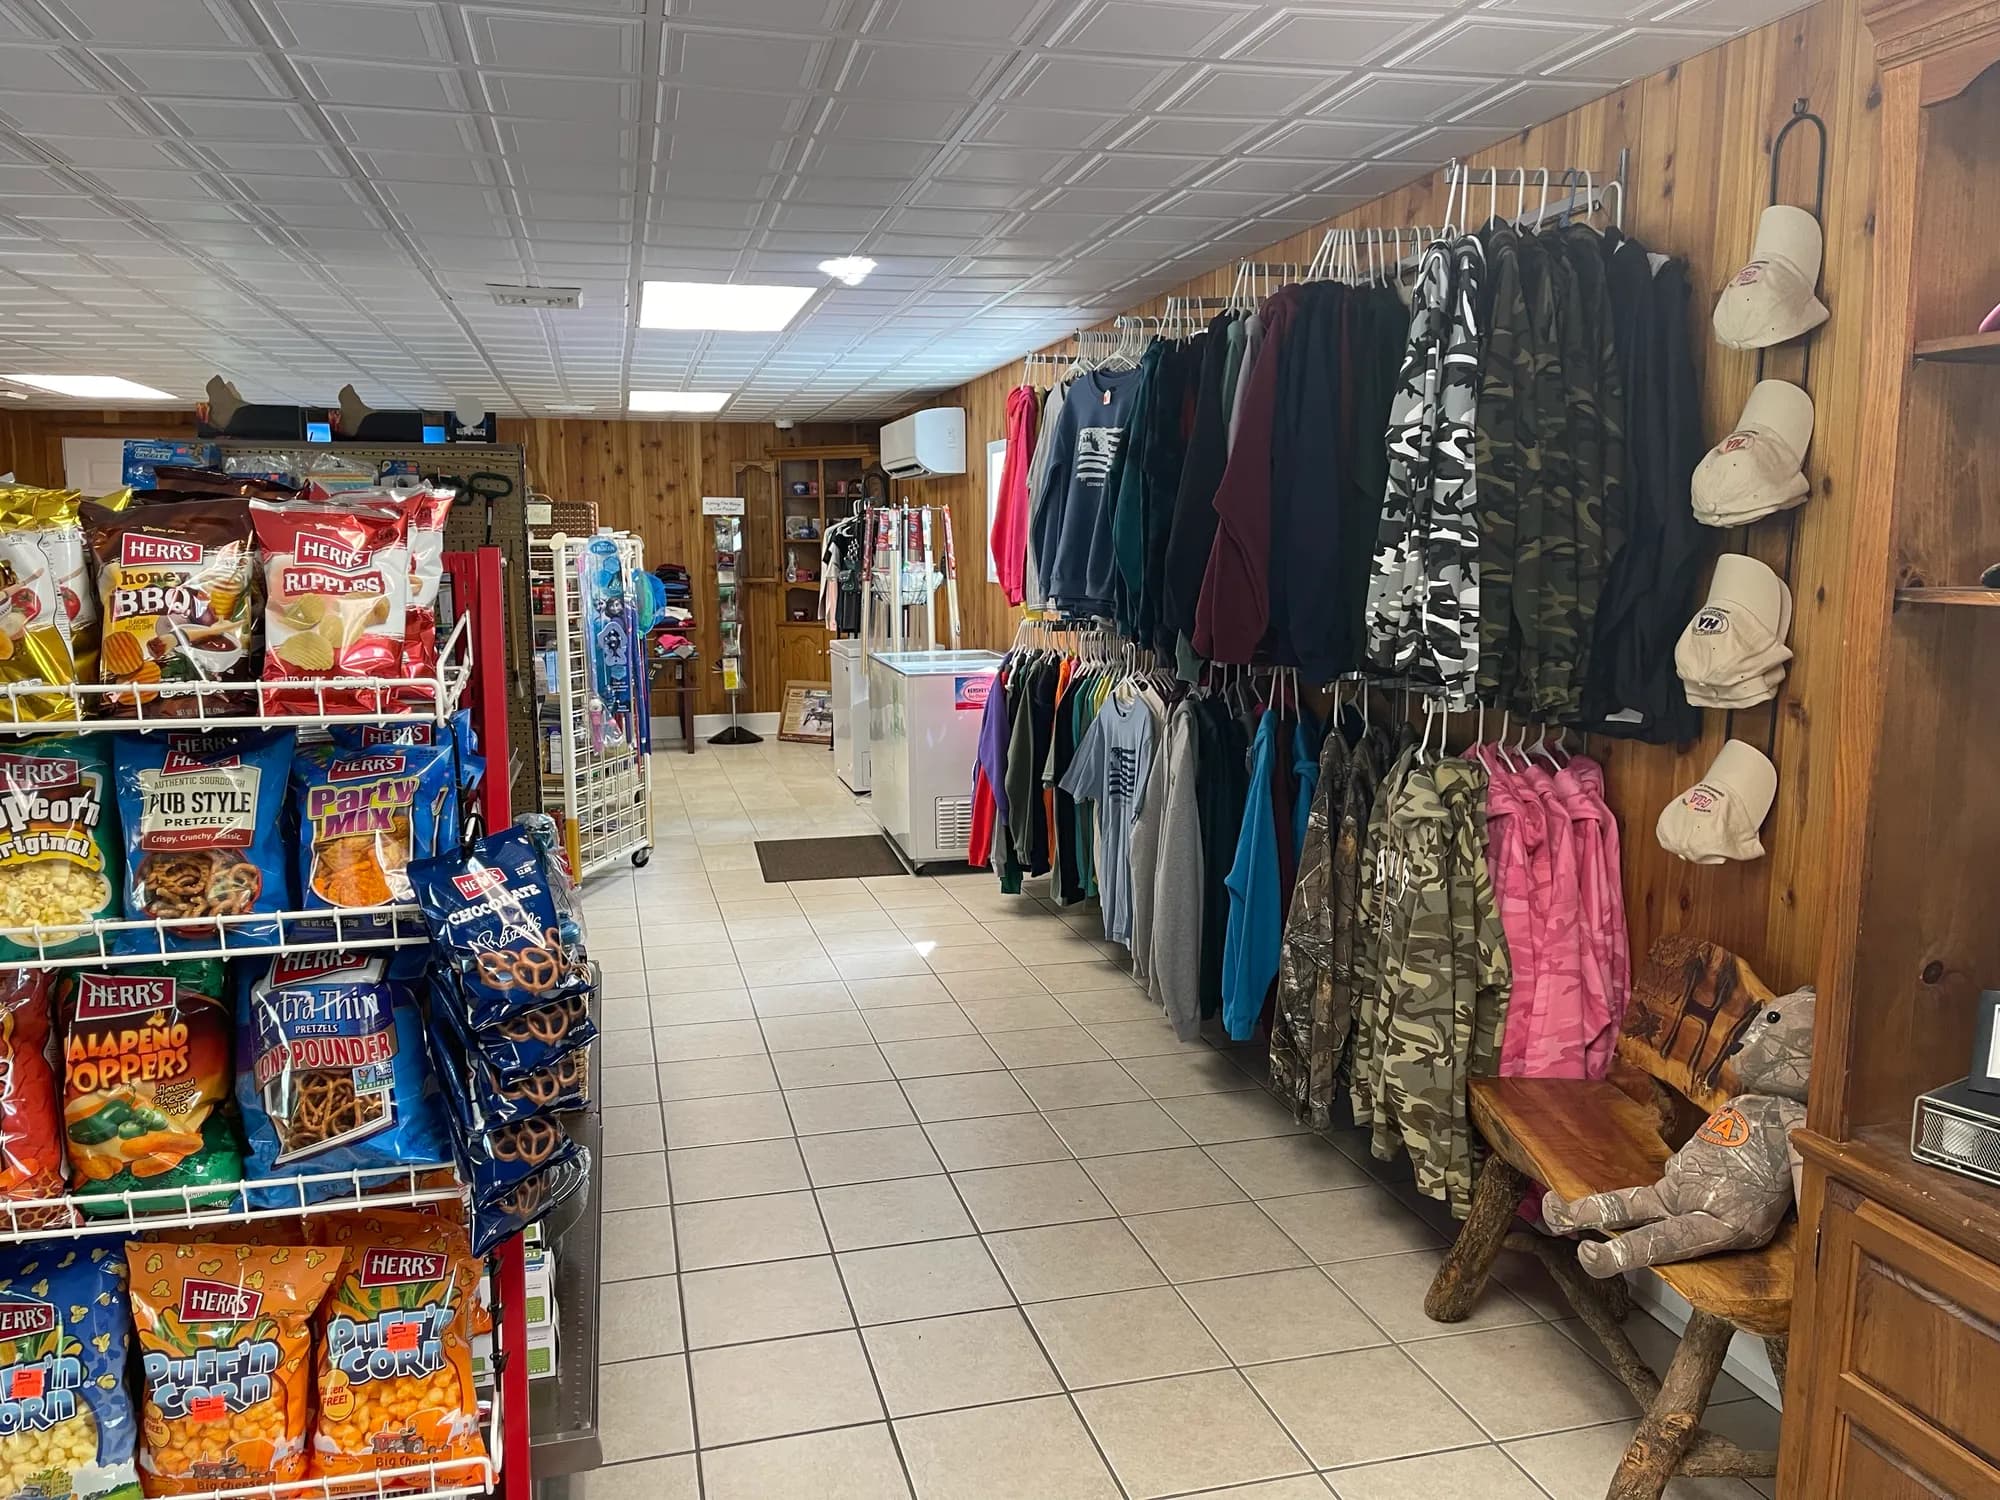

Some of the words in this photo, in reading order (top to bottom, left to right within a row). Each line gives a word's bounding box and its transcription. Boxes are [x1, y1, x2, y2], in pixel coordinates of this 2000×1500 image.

[129, 541, 194, 561] HERR'S
[303, 541, 364, 569] HERR'S
[121, 570, 191, 586] honey
[284, 572, 380, 593] RIPPLES
[114, 586, 191, 619] BBQ
[338, 756, 397, 773] HERR'S
[154, 776, 197, 789] AUTHENTIC
[149, 792, 185, 814] PUB
[191, 791, 251, 814] STYLE
[310, 780, 416, 818] Party
[164, 816, 235, 827] PRETZELS
[0, 833, 91, 859] riginal
[151, 835, 178, 844] Crispy.
[180, 833, 213, 843] Crunchy.
[448, 884, 542, 925] CHOCOLATE
[88, 982, 165, 1008] HERR'S
[319, 987, 380, 1023] Thin
[295, 1024, 338, 1034] PRETZELS
[258, 1048, 289, 1082] ONE
[293, 1031, 393, 1069] POUNDER
[370, 1254, 437, 1277] HERR'S
[190, 1288, 251, 1316] HERR'S
[0, 1308, 47, 1331] ERR'S
[375, 1456, 396, 1468] Big
[197, 1480, 217, 1491] Big
